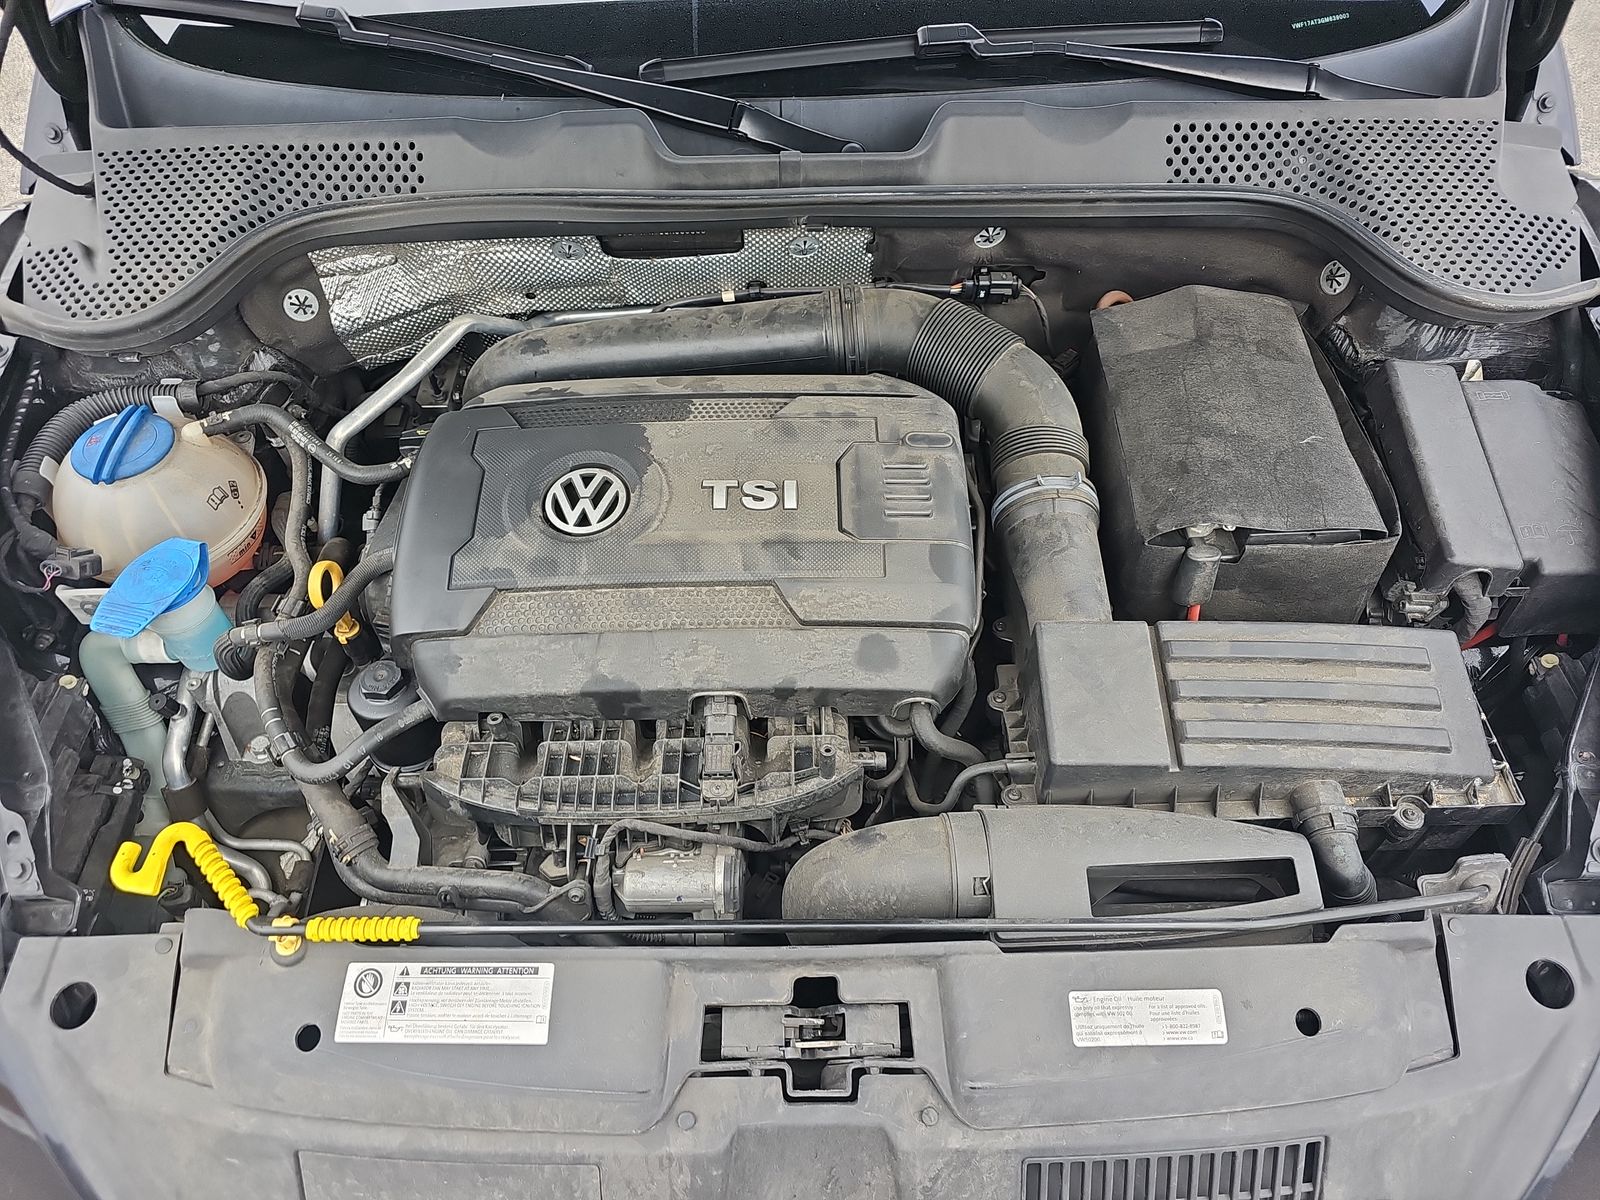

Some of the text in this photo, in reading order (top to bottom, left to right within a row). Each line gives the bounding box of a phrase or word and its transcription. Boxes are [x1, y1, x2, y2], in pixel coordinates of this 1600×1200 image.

[543, 466, 630, 535] VW
[702, 479, 799, 511] TSI
[238, 542, 251, 556] min
